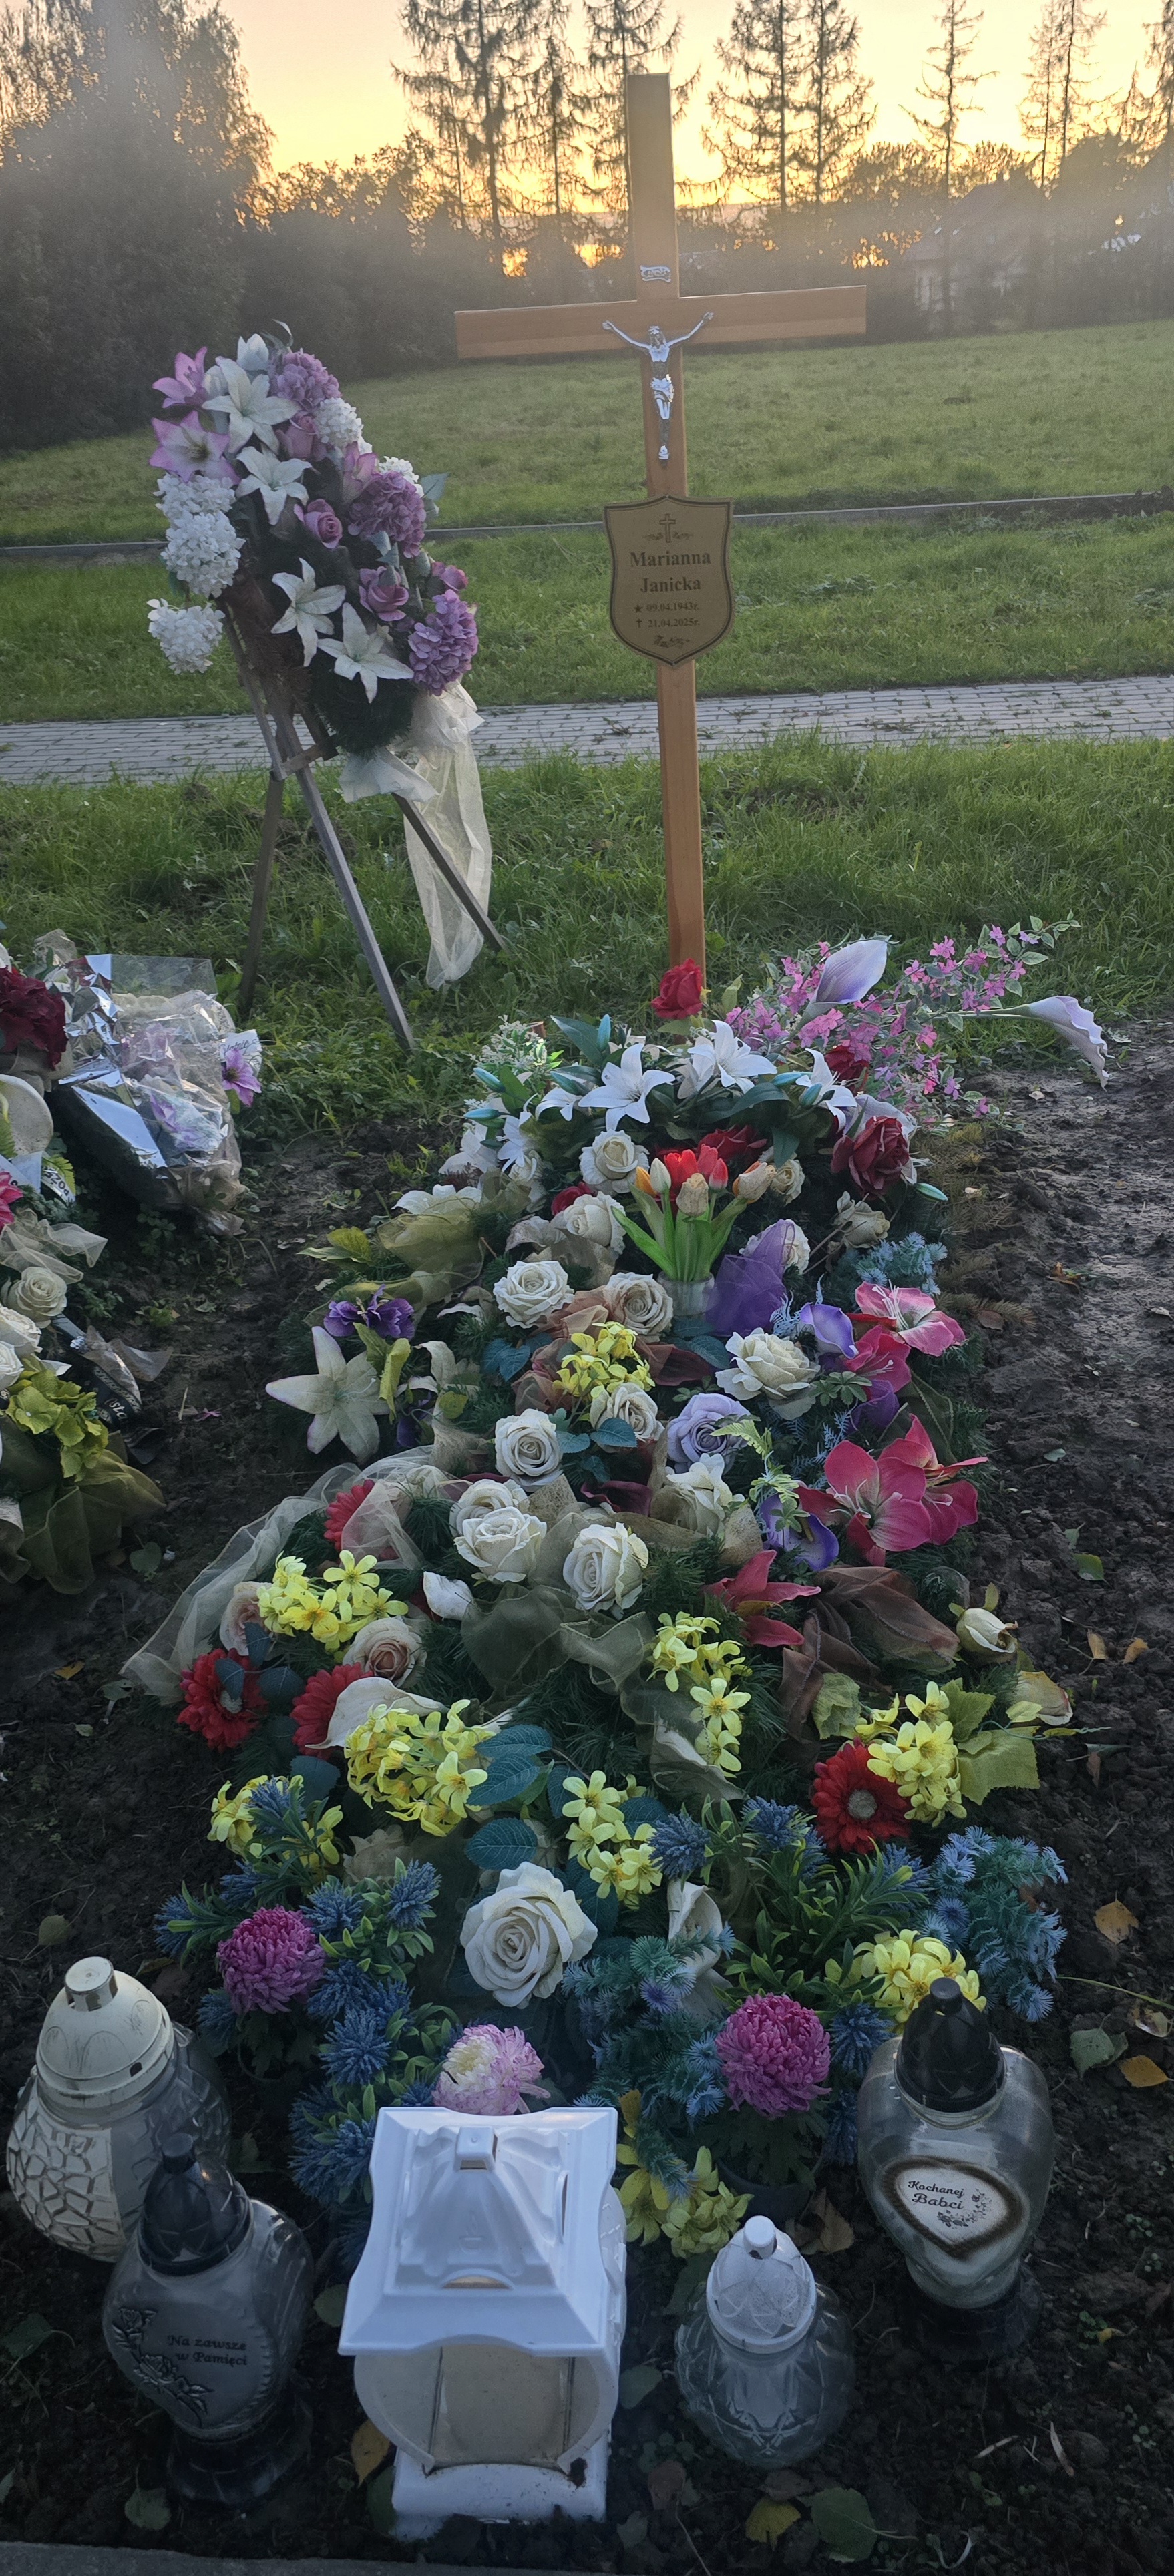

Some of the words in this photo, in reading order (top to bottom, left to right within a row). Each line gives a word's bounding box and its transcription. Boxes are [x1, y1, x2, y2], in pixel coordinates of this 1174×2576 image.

[630, 551, 711, 567] Marianna
[640, 576, 701, 593] Janicka
[647, 618, 701, 628] 21.04.2025r.
[908, 2180, 965, 2199] Kochanej
[912, 2193, 964, 2210] Babci
[168, 2335, 190, 2347] Na
[194, 2338, 247, 2351] zawsze
[176, 2352, 190, 2361] w
[192, 2351, 248, 2366] Pamięci
